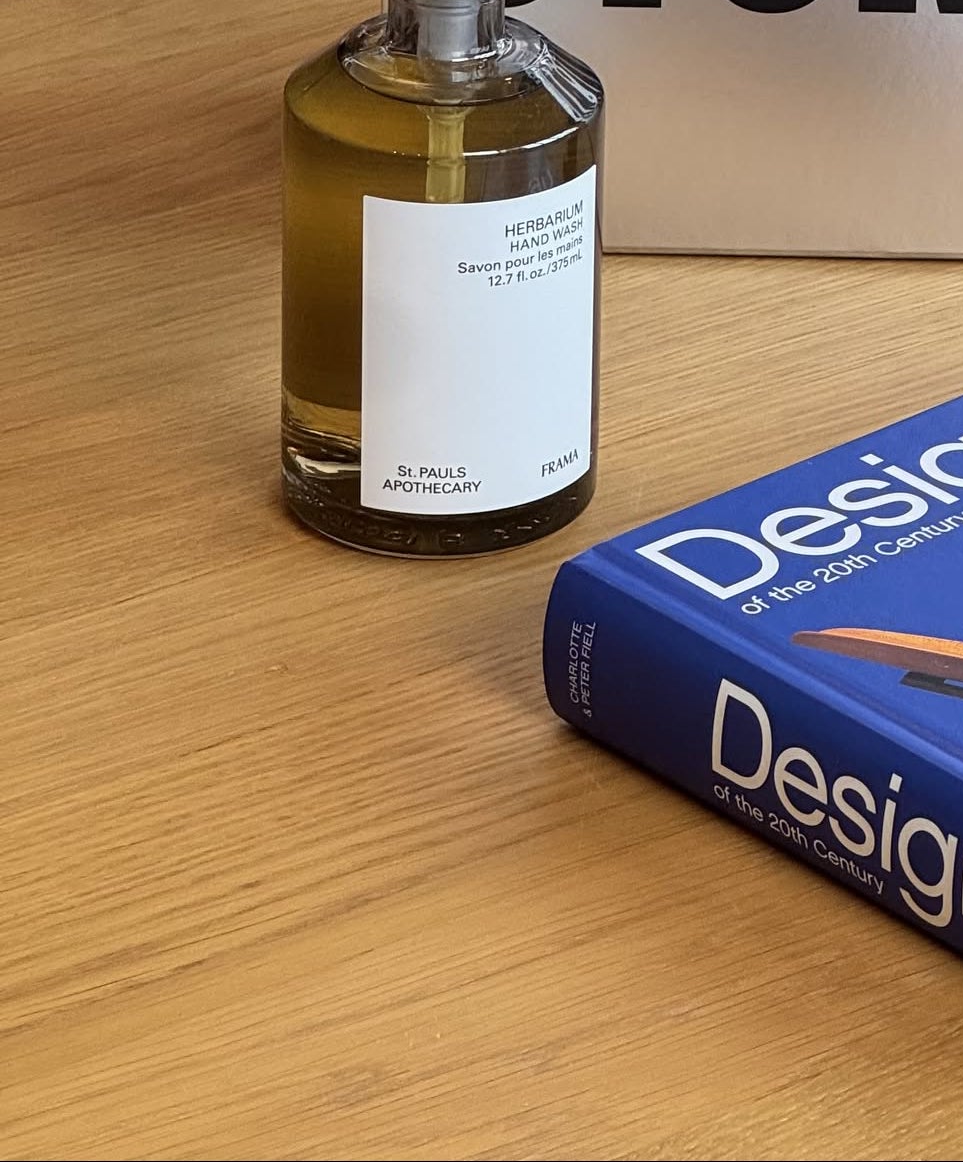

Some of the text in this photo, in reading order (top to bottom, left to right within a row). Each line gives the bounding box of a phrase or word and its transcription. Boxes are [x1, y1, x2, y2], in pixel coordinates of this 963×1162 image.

[505, 199, 583, 238] HERBARIUM
[510, 217, 583, 253] HAND WASH
[457, 235, 583, 274] Savon pour les mains
[488, 273, 513, 287] 12.7
[397, 465, 466, 478] St. PAULS
[541, 448, 579, 477] FRAMA
[382, 479, 482, 494] APOTHECARY
[741, 595, 770, 615] of
[768, 579, 816, 601] the
[813, 554, 878, 583] 20th
[568, 620, 583, 704] CHARLOTTE
[580, 621, 597, 718] & PETER FIELL
[713, 785, 884, 895] of the 20th Century
